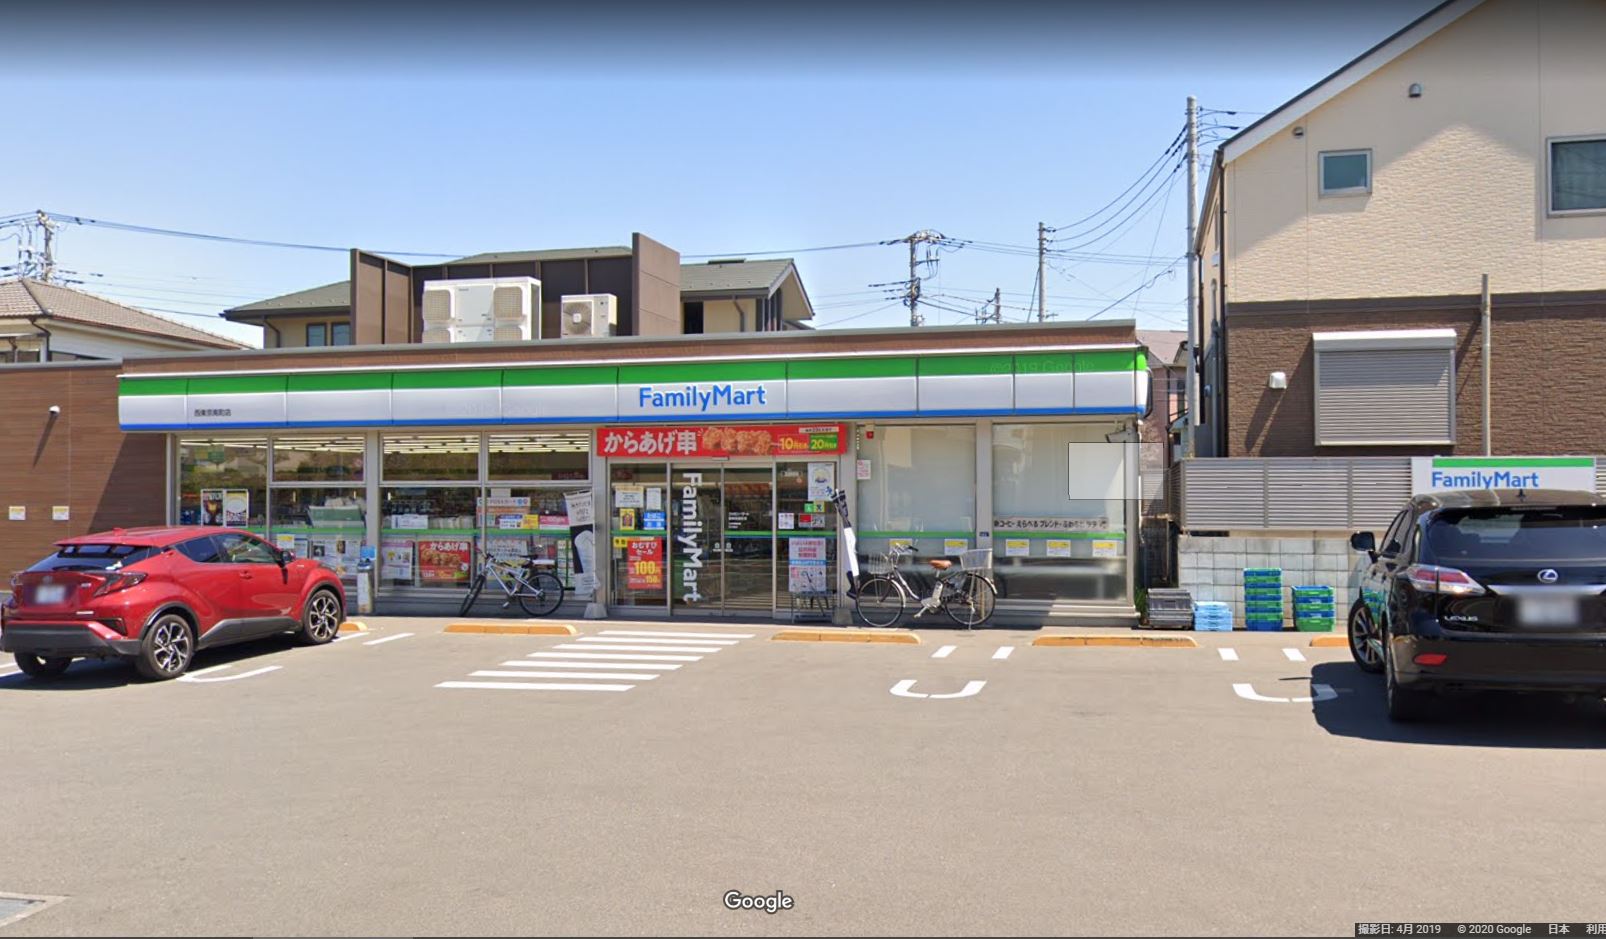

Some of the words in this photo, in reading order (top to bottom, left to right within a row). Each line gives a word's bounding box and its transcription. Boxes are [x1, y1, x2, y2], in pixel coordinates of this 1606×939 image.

[639, 385, 766, 411] FamilyMart
[604, 429, 698, 455] からあげ串
[1431, 471, 1539, 489] FamilyMart
[677, 472, 703, 602] FamilyMart
